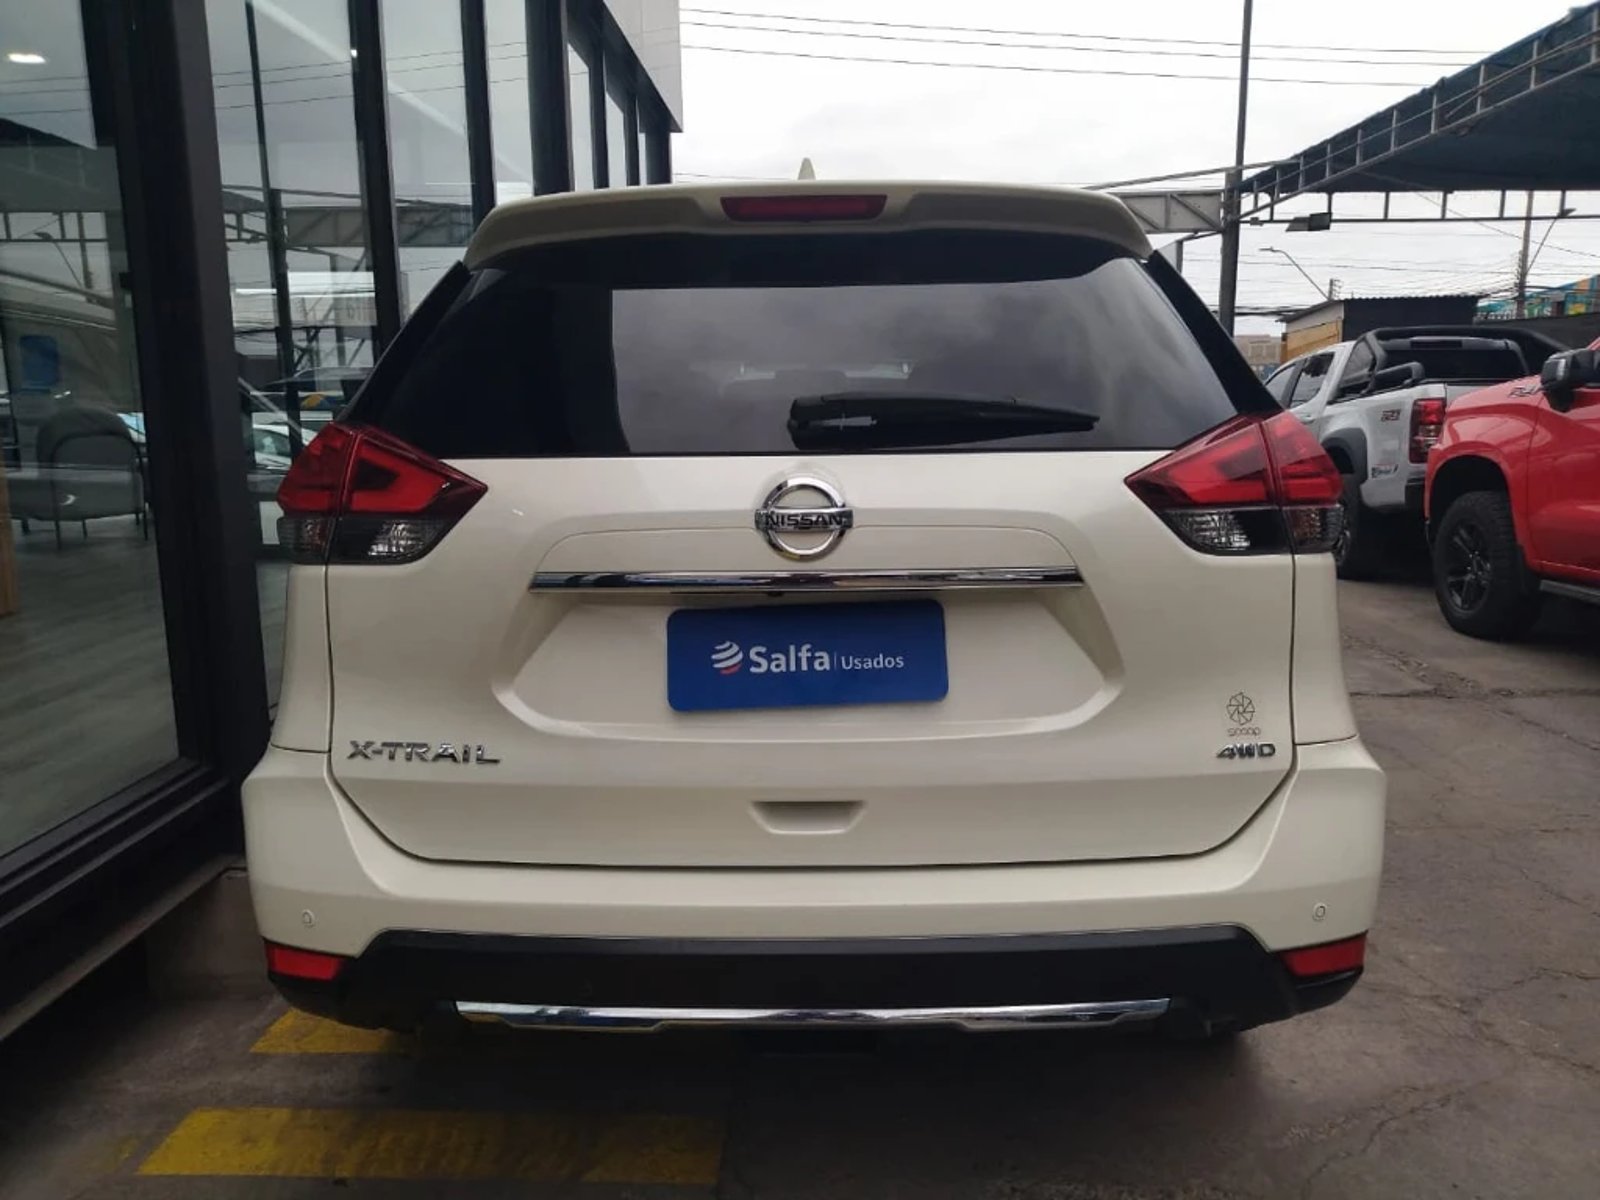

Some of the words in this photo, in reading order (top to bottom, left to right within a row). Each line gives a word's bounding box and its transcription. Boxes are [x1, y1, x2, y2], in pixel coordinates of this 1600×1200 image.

[765, 513, 843, 527] NISSAN
[749, 643, 831, 675] Salfa
[841, 653, 905, 671] Usados
[347, 740, 501, 765] X-TRAIL
[1216, 743, 1276, 760] 4WD
